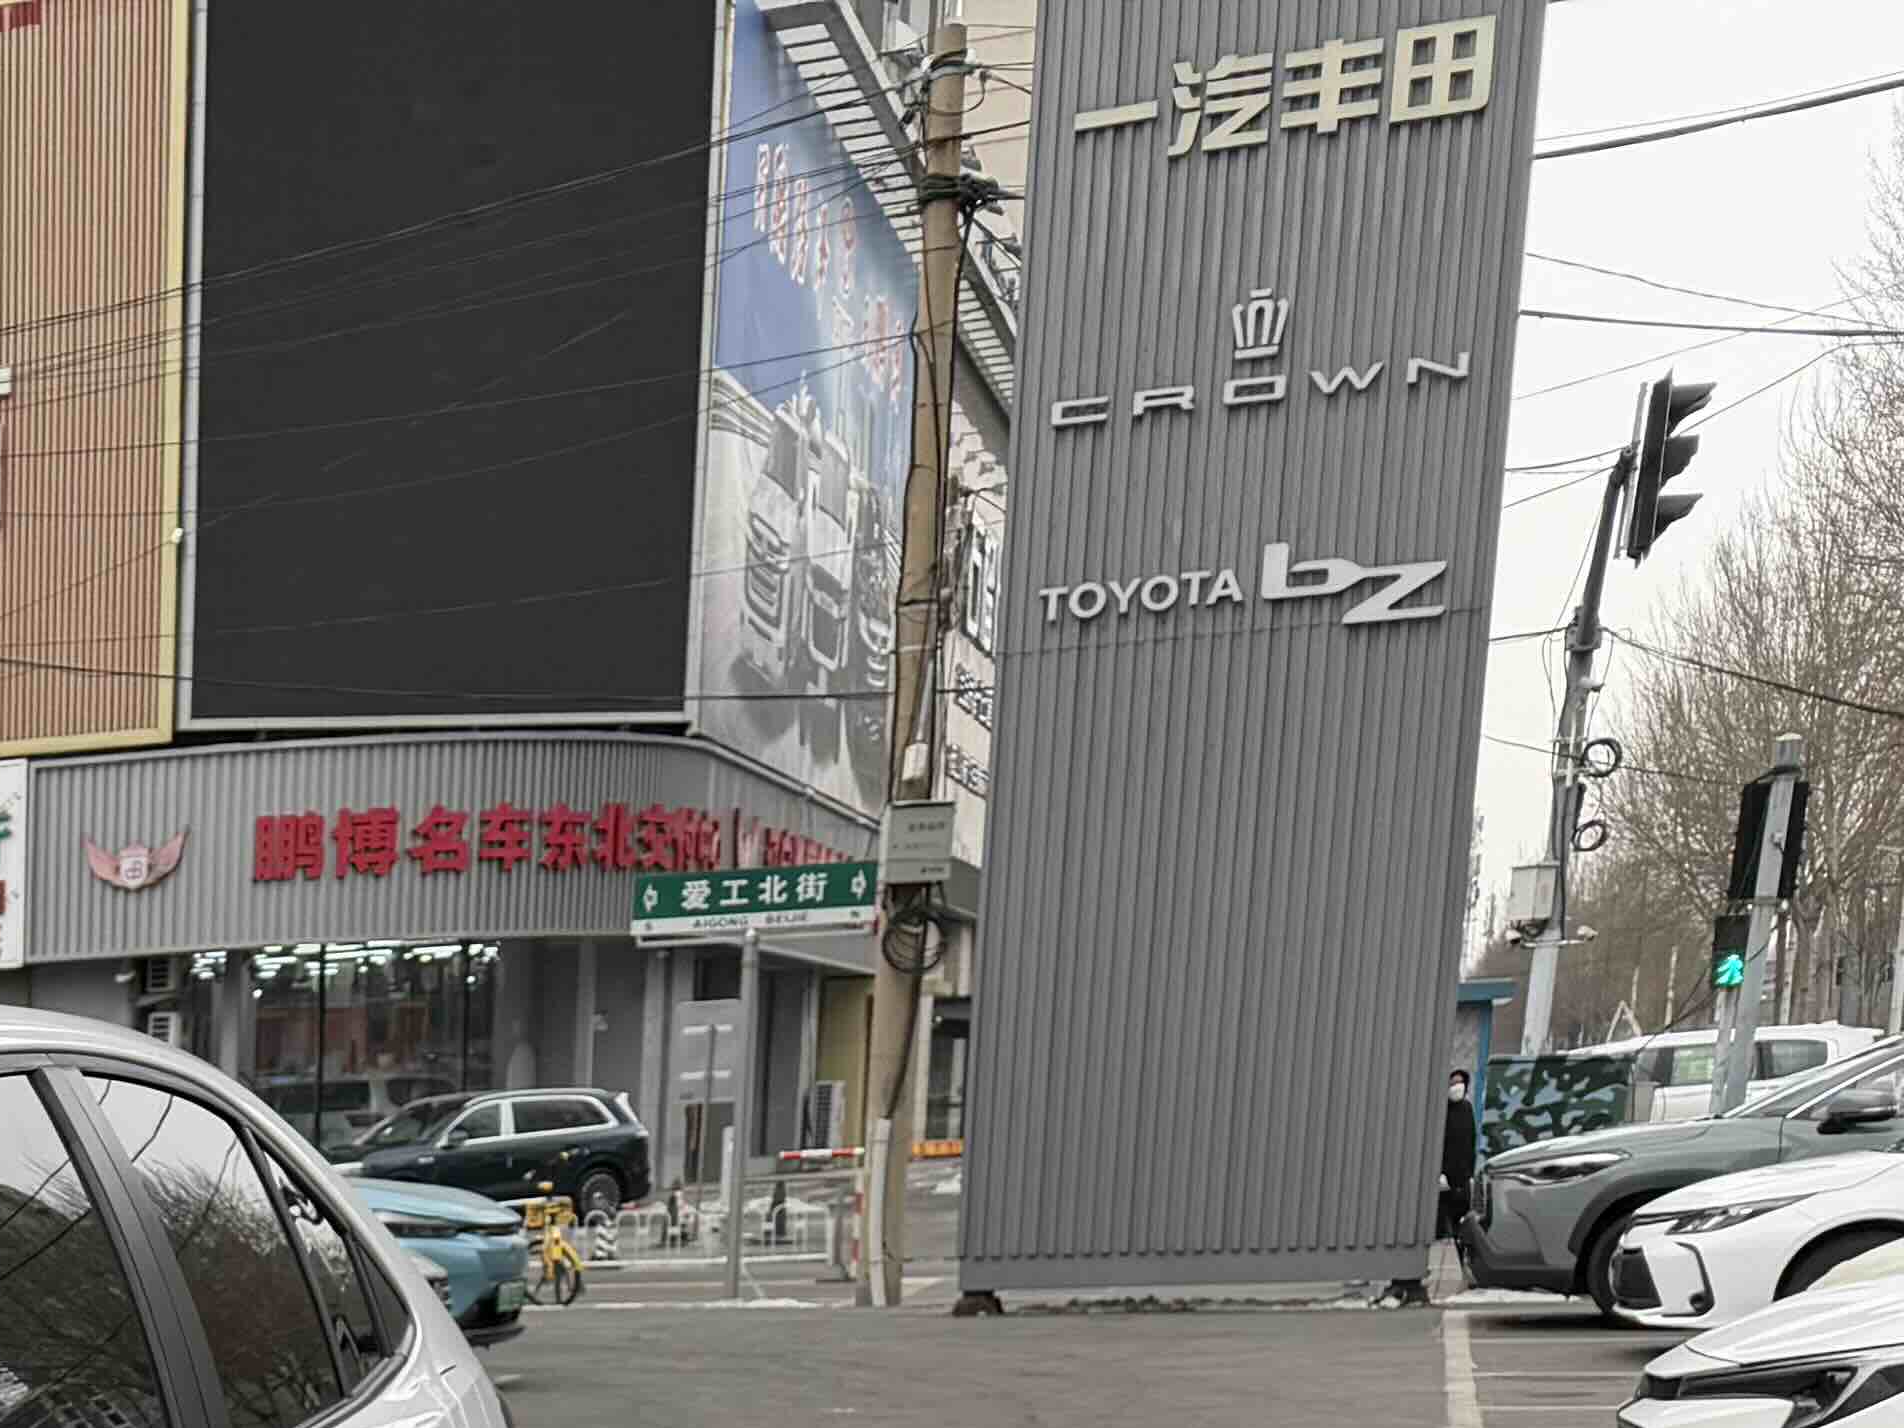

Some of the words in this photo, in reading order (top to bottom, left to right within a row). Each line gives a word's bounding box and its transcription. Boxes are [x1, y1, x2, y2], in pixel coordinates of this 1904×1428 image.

[1073, 15, 1497, 159] 一汽丰田
[1051, 351, 1470, 428] CROWN
[1038, 567, 1242, 624] TOYOTA
[680, 872, 829, 912] 爱工北街
[692, 917, 749, 930] AIGONG
